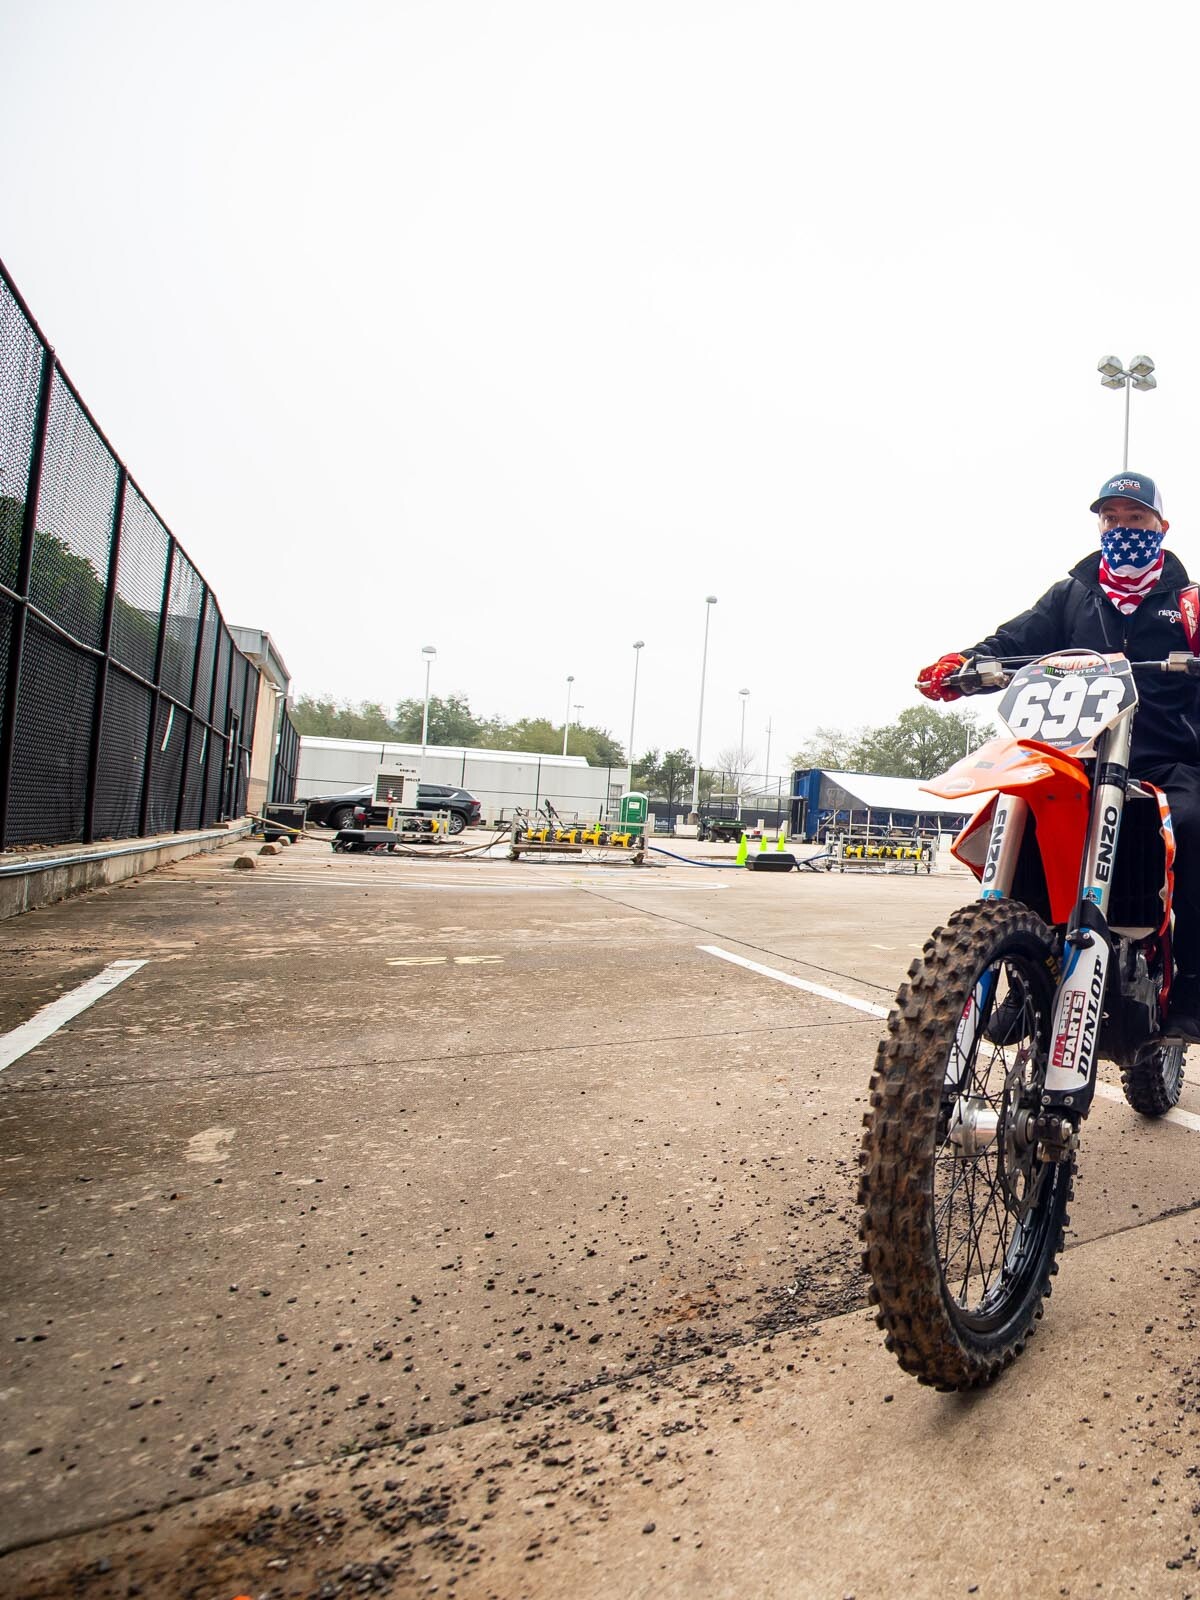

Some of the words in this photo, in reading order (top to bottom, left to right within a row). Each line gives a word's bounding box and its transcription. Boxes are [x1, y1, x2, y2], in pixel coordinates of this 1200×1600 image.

[1158, 609, 1182, 624] niaga
[1006, 674, 1126, 740] 693
[984, 810, 1008, 882] ENZO
[1096, 806, 1118, 882] ENZO
[1062, 995, 1084, 1067] PARTS
[1077, 958, 1104, 1081] DUNLOP
